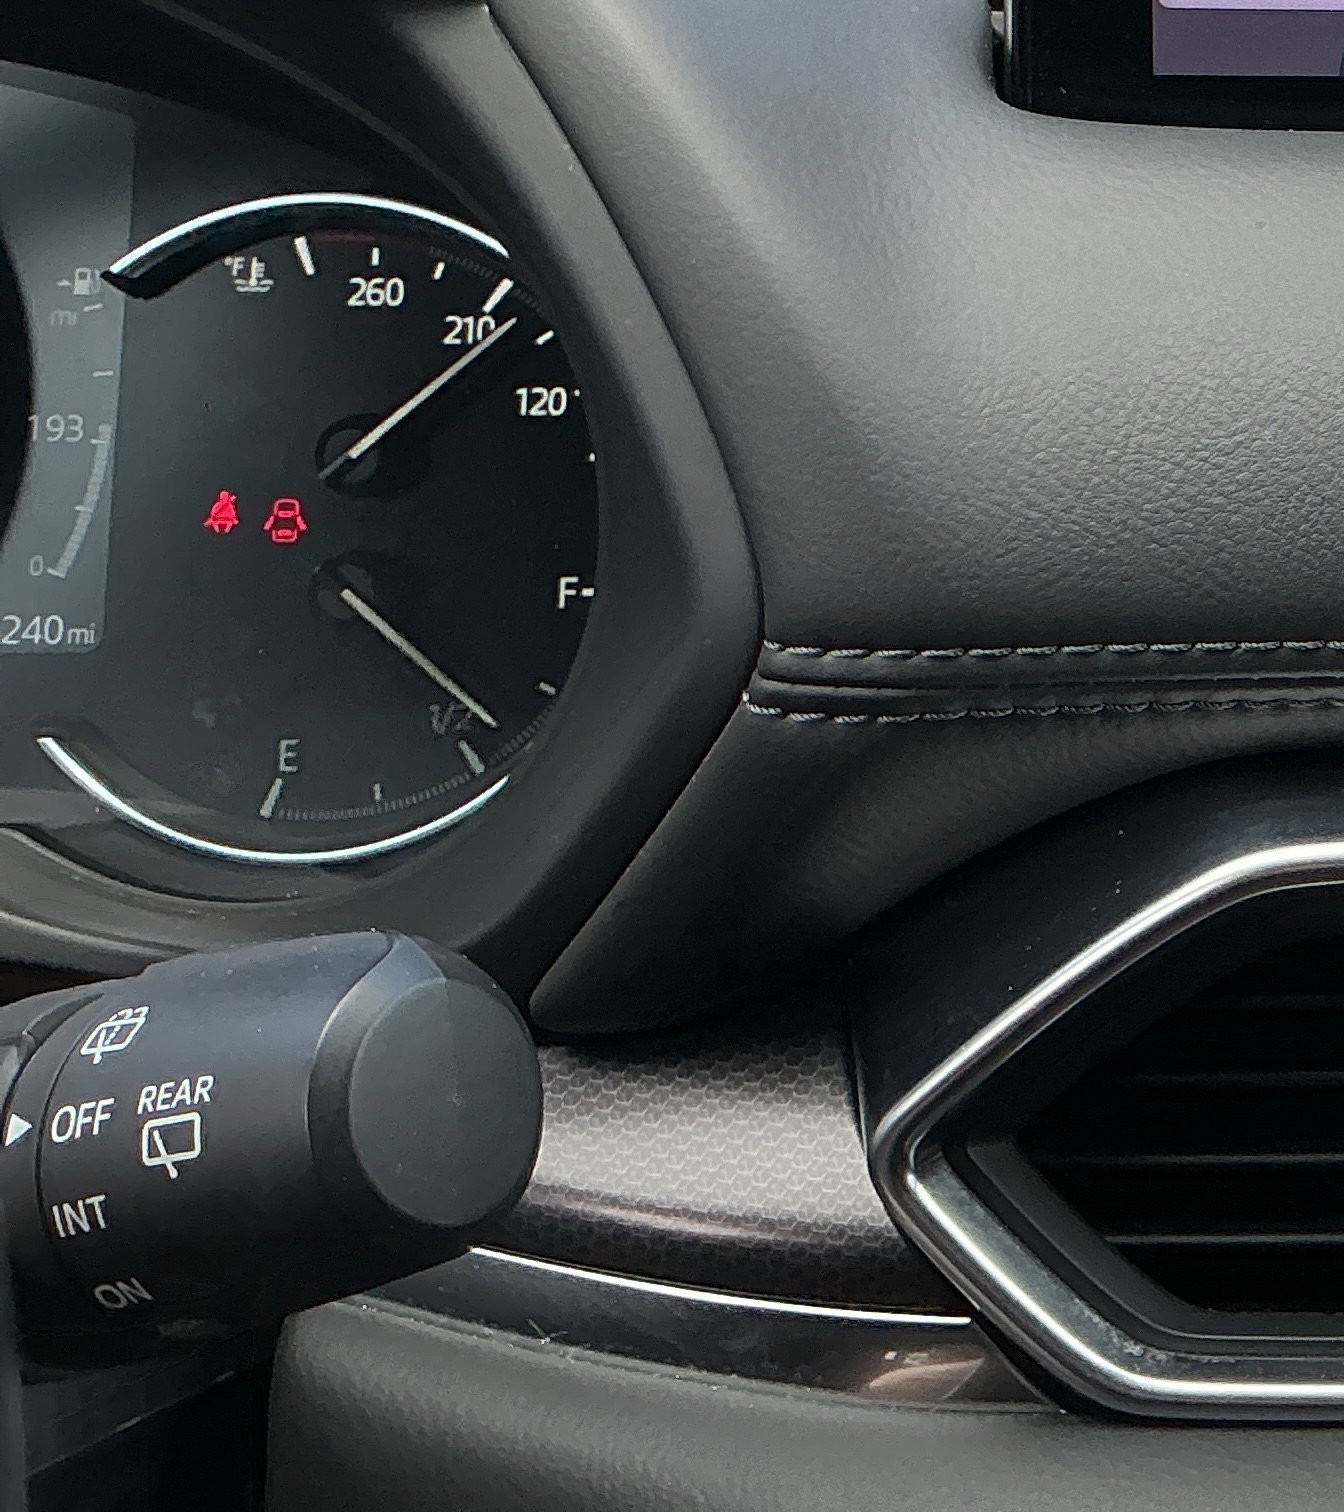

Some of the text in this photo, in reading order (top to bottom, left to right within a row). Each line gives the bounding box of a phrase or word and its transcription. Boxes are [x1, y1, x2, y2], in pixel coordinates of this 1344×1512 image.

[347, 277, 405, 307] 260
[442, 314, 496, 346] 210
[514, 386, 567, 417] 120
[28, 413, 84, 442] 193
[29, 554, 44, 577] 0
[557, 576, 580, 611] F
[277, 738, 301, 774] E
[137, 1074, 215, 1116] REAR
[51, 1097, 116, 1144] OFF
[52, 1193, 107, 1238] INT
[93, 1276, 154, 1310] ON
